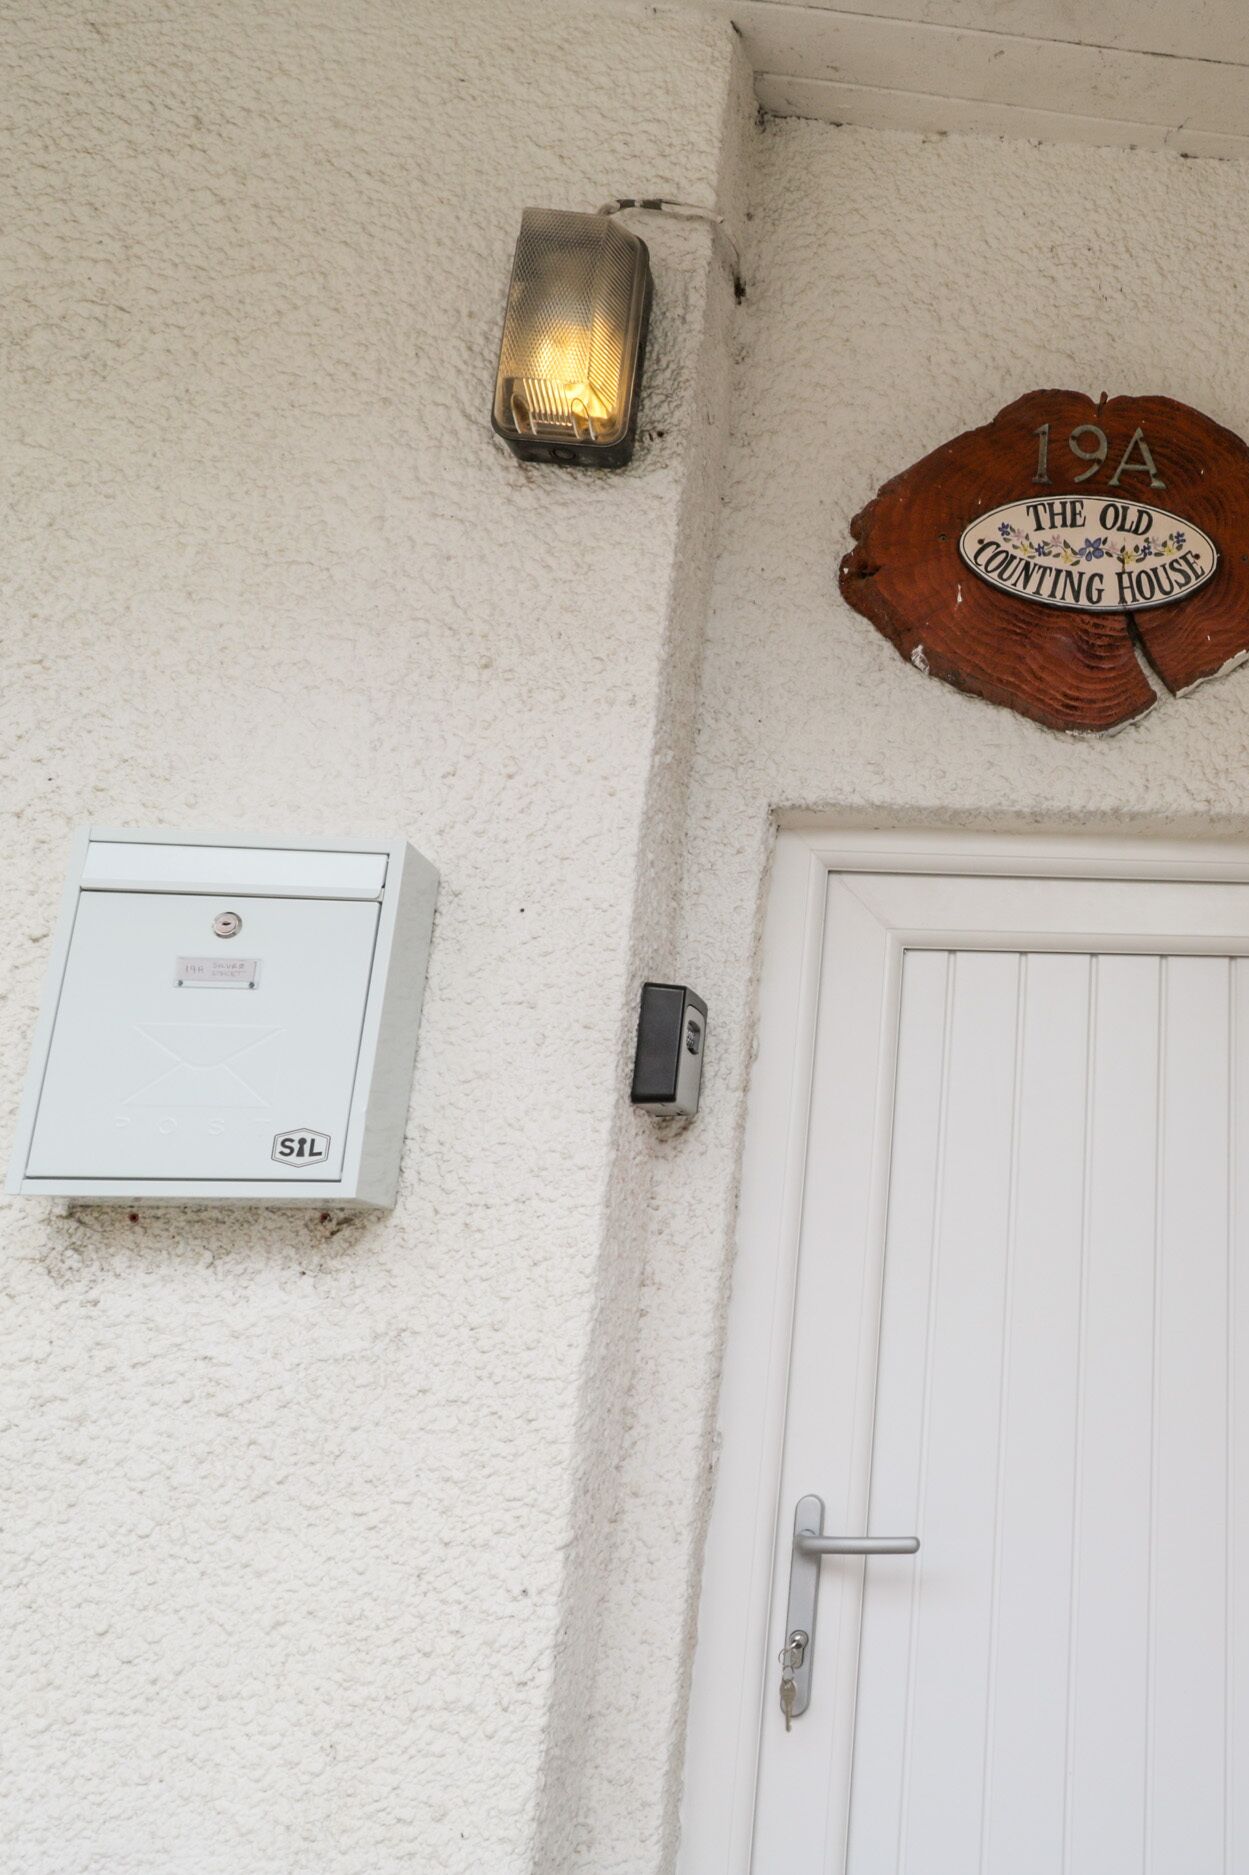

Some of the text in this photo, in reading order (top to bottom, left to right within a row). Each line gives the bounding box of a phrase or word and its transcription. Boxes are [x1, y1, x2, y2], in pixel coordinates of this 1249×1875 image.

[1032, 423, 1167, 489] 19A
[1026, 500, 1154, 536] THE OLD
[973, 541, 1206, 605] COUNTING HOUSE
[278, 1137, 323, 1157] SIL
